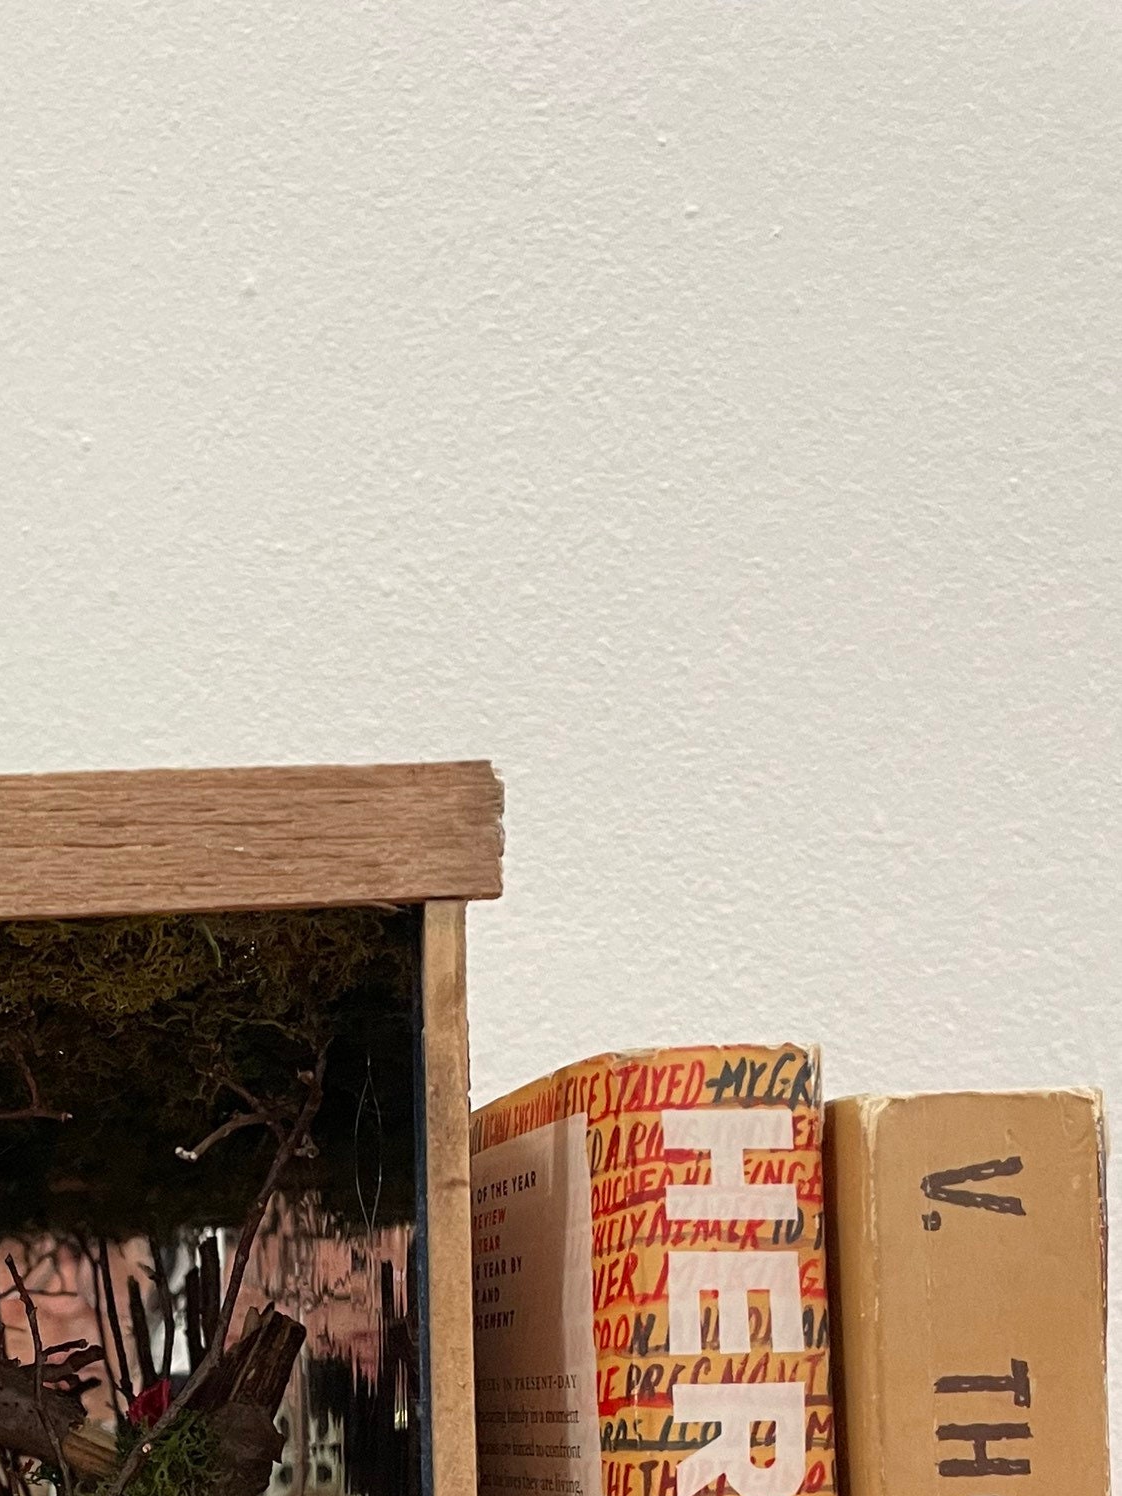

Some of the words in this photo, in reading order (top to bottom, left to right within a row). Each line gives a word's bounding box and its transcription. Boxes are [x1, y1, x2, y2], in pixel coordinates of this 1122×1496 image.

[604, 1059, 706, 1120] STAYED
[491, 1180, 508, 1199] THE
[512, 1171, 537, 1193] YEAR
[591, 1163, 675, 1218] OUCHED
[920, 1156, 1027, 1231] V.
[511, 1256, 522, 1274] BY
[515, 1374, 577, 1391] PRESENT-DAY
